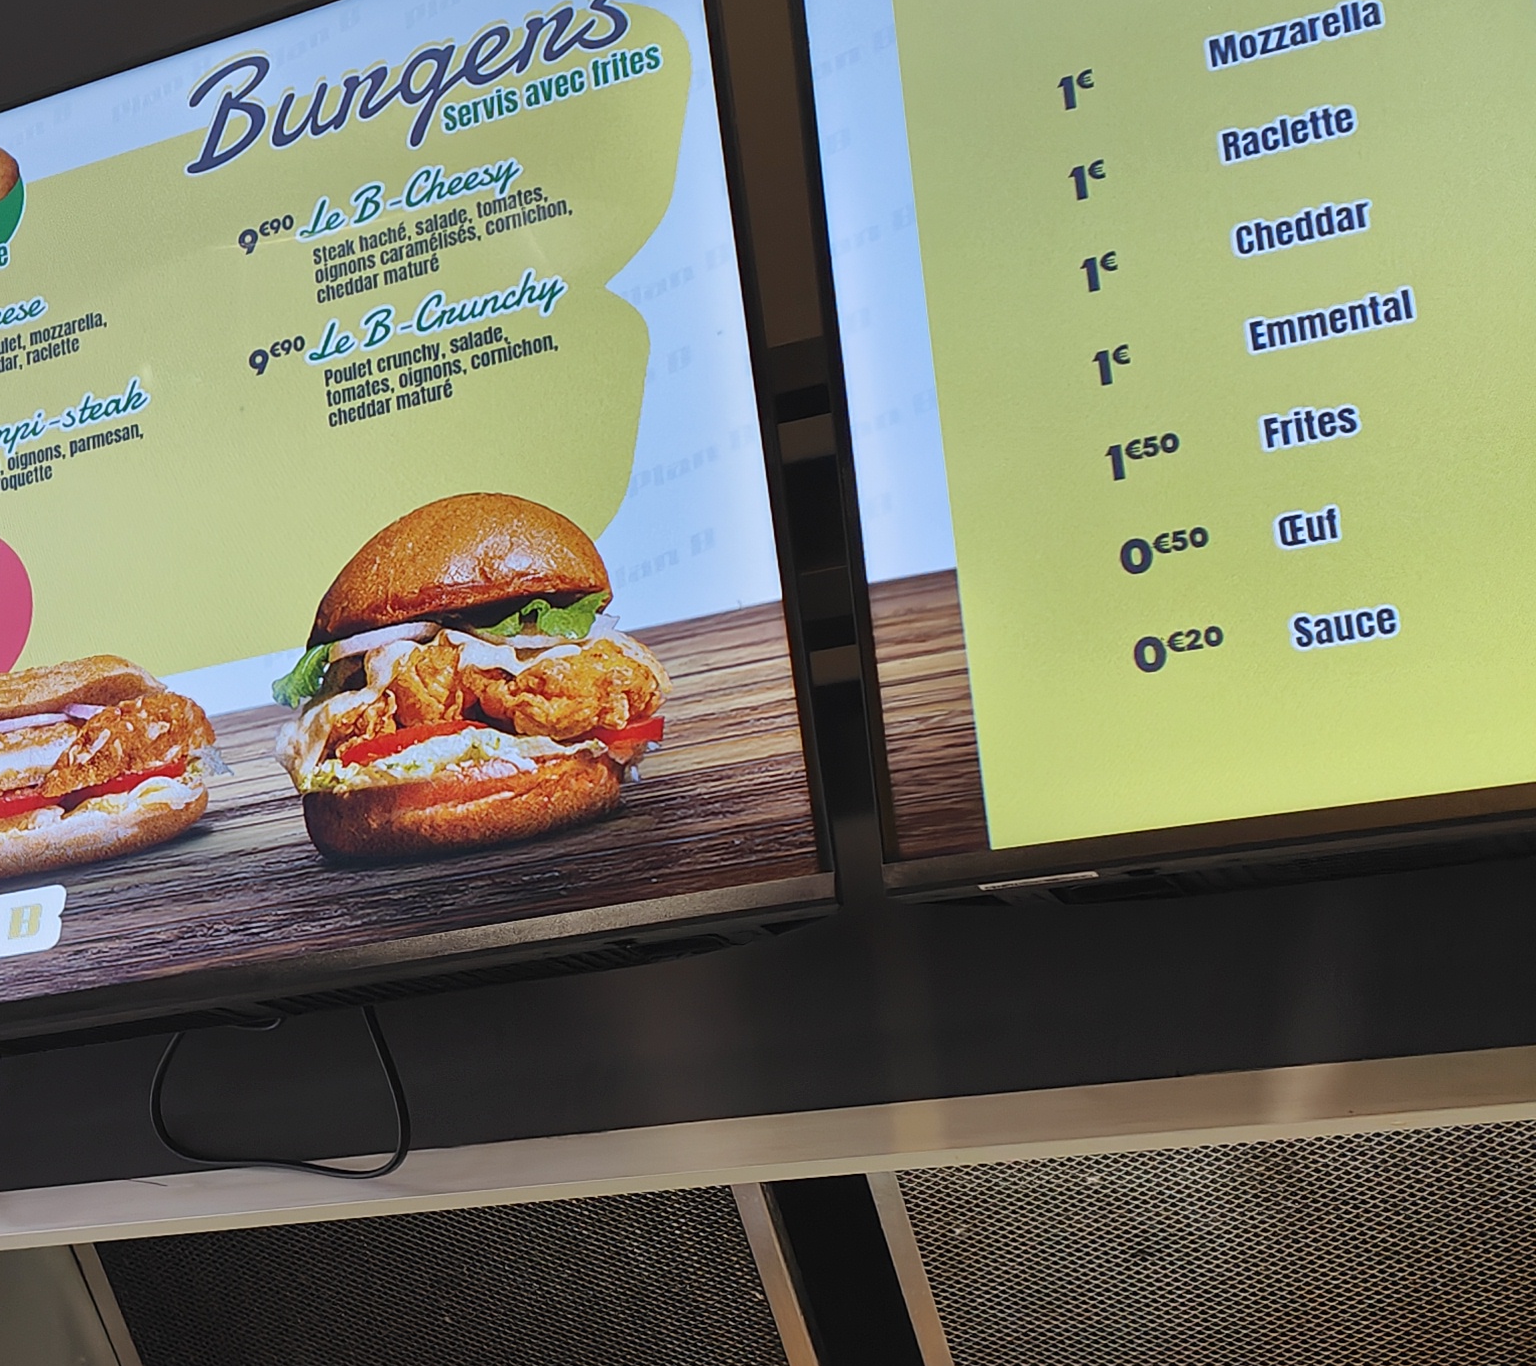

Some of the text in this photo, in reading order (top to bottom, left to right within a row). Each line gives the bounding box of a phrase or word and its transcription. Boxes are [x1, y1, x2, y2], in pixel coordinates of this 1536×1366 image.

[1209, 1, 1382, 67] Mozzarella
[442, 46, 660, 132] Servis avec frites
[1057, 68, 1095, 111] 1€
[1222, 107, 1354, 162] Raclette
[1068, 159, 1106, 200] 1€
[238, 215, 294, 255] 9€90
[300, 199, 345, 237] Le
[313, 187, 548, 264] Steak haché, salade, tomates,
[315, 199, 573, 284] oignons caramélisés, cornichon,
[1236, 203, 1368, 255] Cheddar
[316, 255, 440, 303] cheddar maturé
[1080, 251, 1118, 293] 1€
[29, 311, 107, 346] mozzarella,
[1250, 289, 1413, 351] Emmental
[26, 337, 80, 365] raclette
[248, 336, 306, 376] 9€90
[310, 322, 354, 360] Le
[324, 326, 508, 386] Poulet crunchy, salade,
[327, 335, 558, 407] tomates, oignons, cornichon,
[1093, 344, 1131, 386] 1€
[328, 381, 453, 428] cheddar maturé
[1265, 407, 1358, 449] Frites
[7, 446, 66, 472] oignons,
[69, 423, 144, 457] parmesan,
[1105, 433, 1180, 481] 1€50
[1120, 527, 1208, 574] 0€50
[1278, 508, 1338, 546] Œuf
[1134, 626, 1223, 673] 0€20
[1293, 608, 1396, 647] Sauce
[9, 904, 43, 939] B
